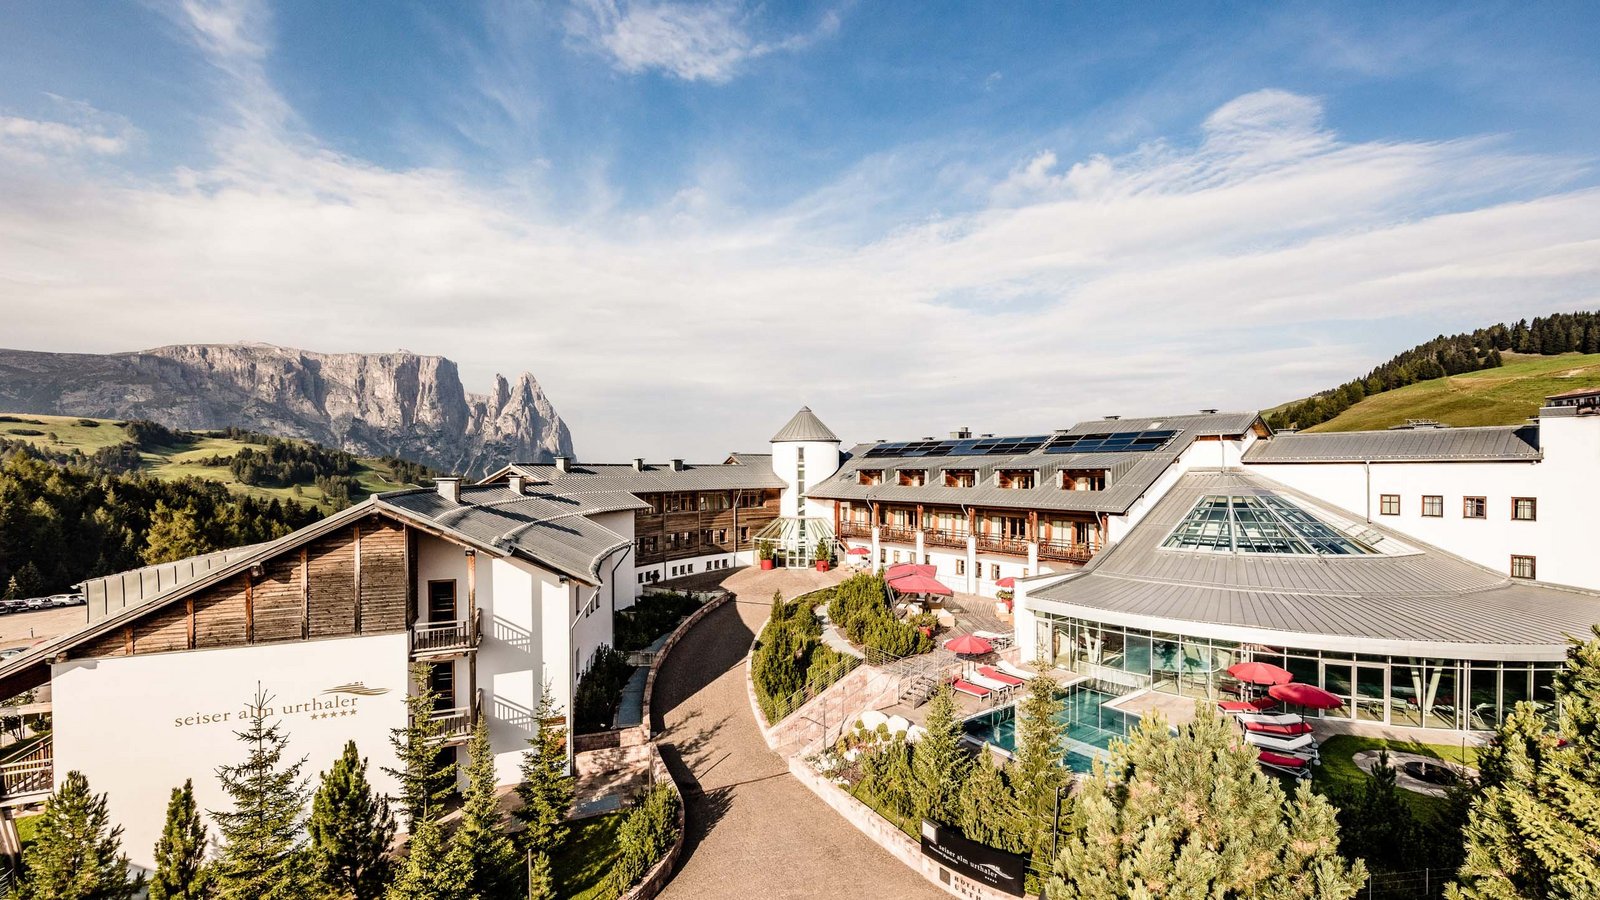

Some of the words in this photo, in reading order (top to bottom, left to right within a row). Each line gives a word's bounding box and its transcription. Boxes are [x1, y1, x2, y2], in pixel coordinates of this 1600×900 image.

[175, 711, 231, 727] seiser
[238, 705, 274, 720] alm
[282, 695, 358, 714] urthaler
[938, 844, 956, 858] seiser
[956, 855, 969, 865] alm
[969, 861, 998, 878] urthaler
